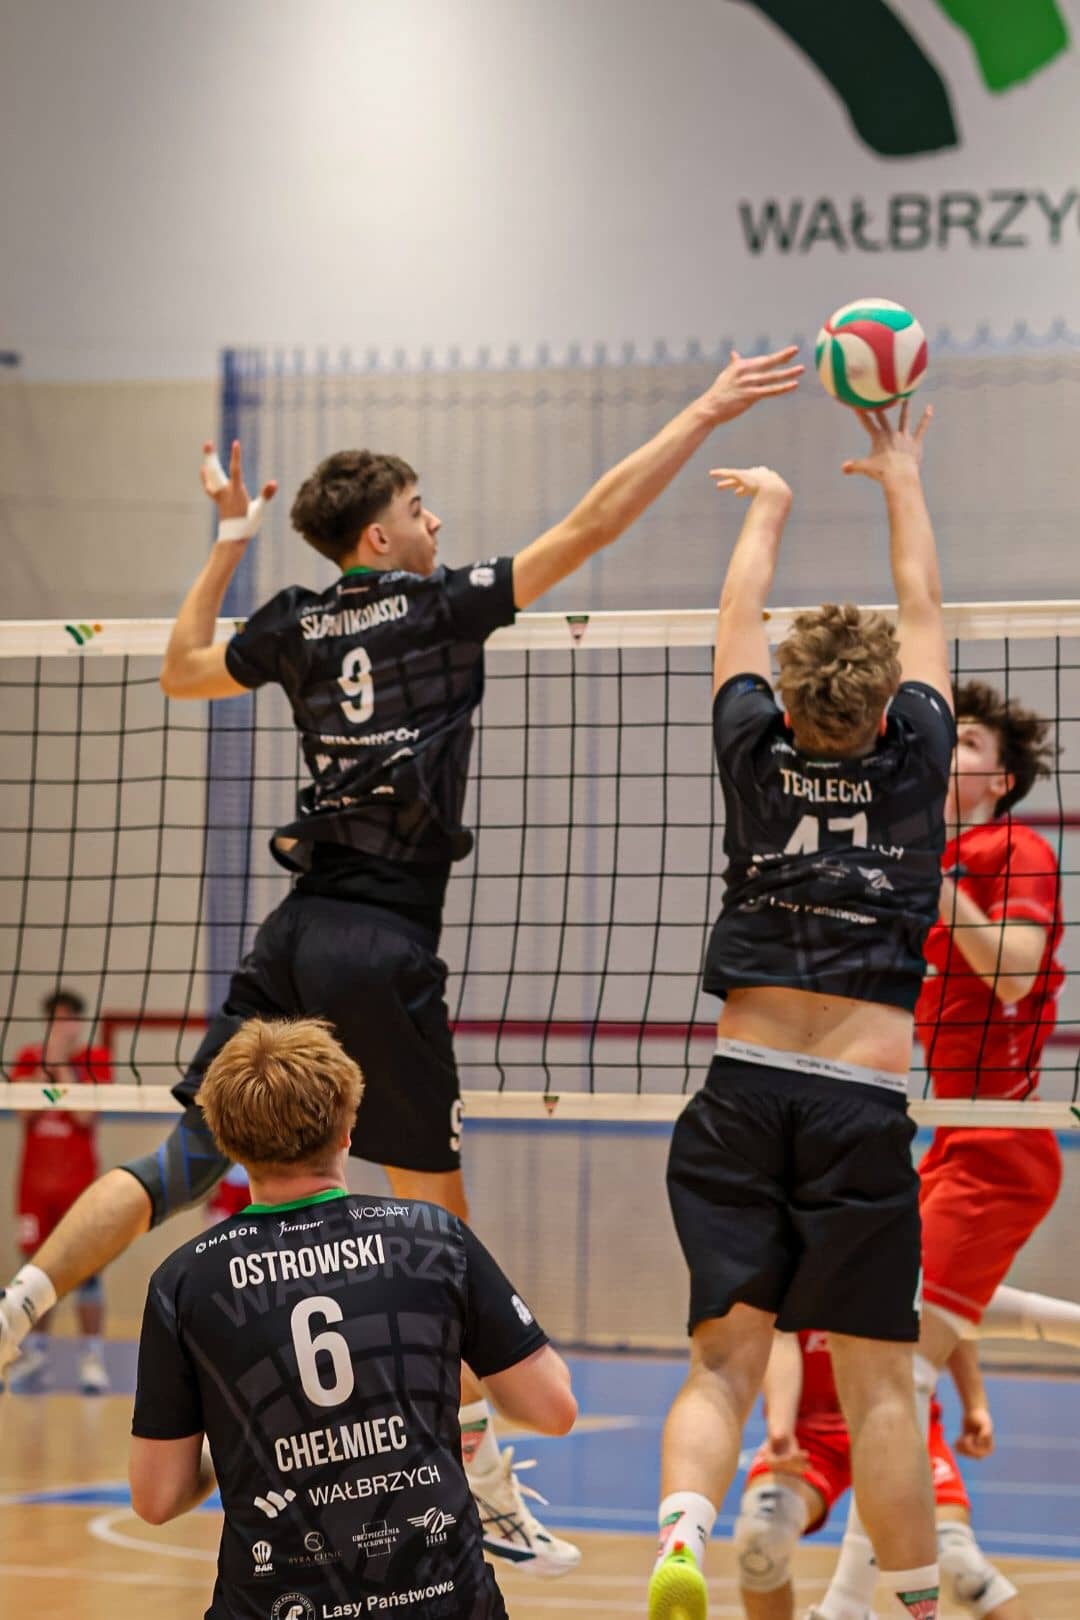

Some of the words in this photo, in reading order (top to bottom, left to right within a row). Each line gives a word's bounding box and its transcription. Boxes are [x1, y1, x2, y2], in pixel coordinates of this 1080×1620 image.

[738, 188, 1080, 256] WAŁBRZY
[337, 646, 375, 724] 9
[779, 768, 873, 804] TERLECKI
[349, 1205, 411, 1221] WOBART
[208, 1225, 259, 1248] MABOR
[229, 1233, 386, 1290] OSTROWSKI
[290, 1295, 355, 1408] 6
[274, 1415, 407, 1473] CHEŁMIEC
[308, 1464, 442, 1507] WAŁBRZYCH
[254, 1562, 273, 1573] BAR
[322, 1602, 362, 1619] Lasy
[367, 1580, 455, 1611] Państwowe
